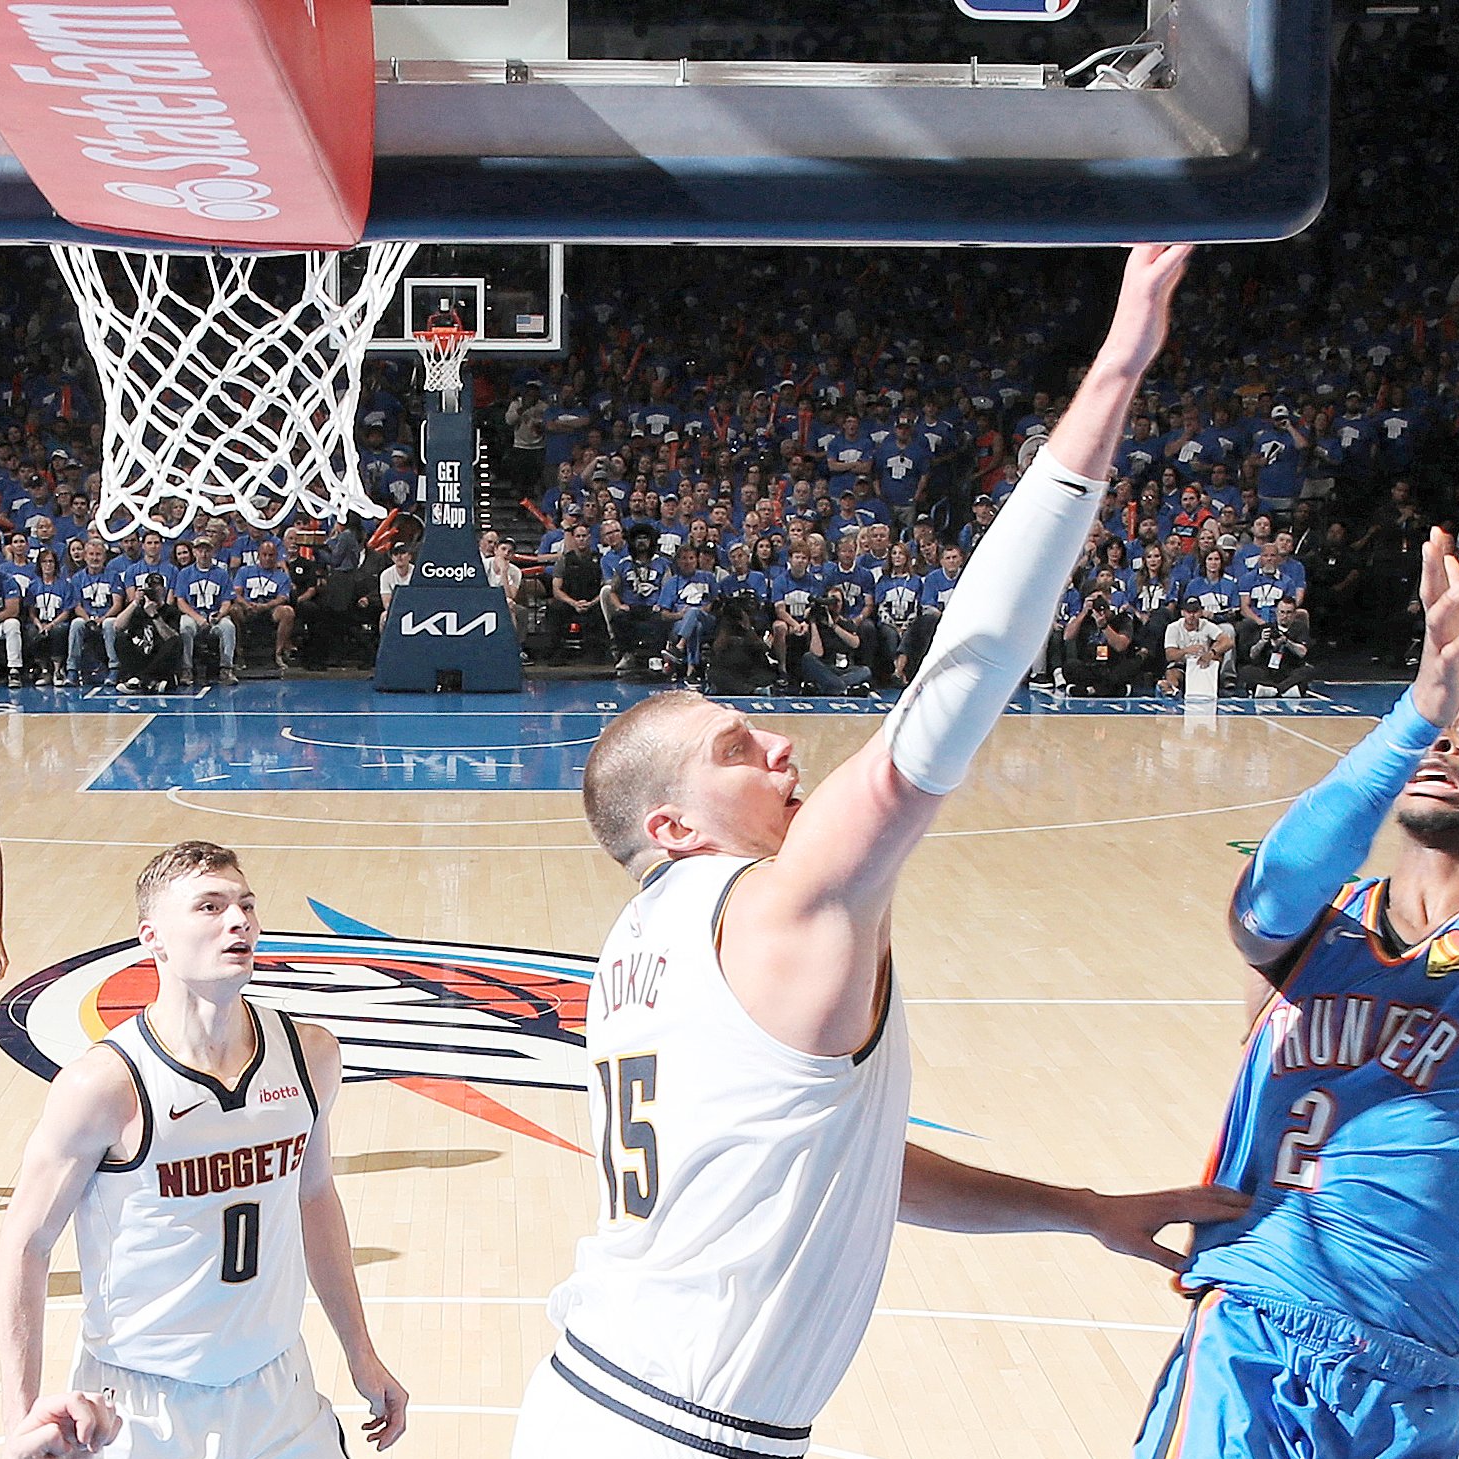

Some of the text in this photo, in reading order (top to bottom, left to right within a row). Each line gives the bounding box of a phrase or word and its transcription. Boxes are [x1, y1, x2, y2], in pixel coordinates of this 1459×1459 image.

[437, 461, 460, 481] GET
[437, 483, 460, 502] THE
[443, 507, 466, 528] App
[421, 562, 476, 581] Google
[401, 612, 497, 636] KIA
[599, 949, 669, 1020] JOKIĆ
[259, 1085, 299, 1103] ibotta
[594, 1052, 659, 1222] 15
[1273, 1087, 1336, 1192] 2
[156, 1132, 308, 1198] NUGGETS
[220, 1201, 261, 1284] 0
